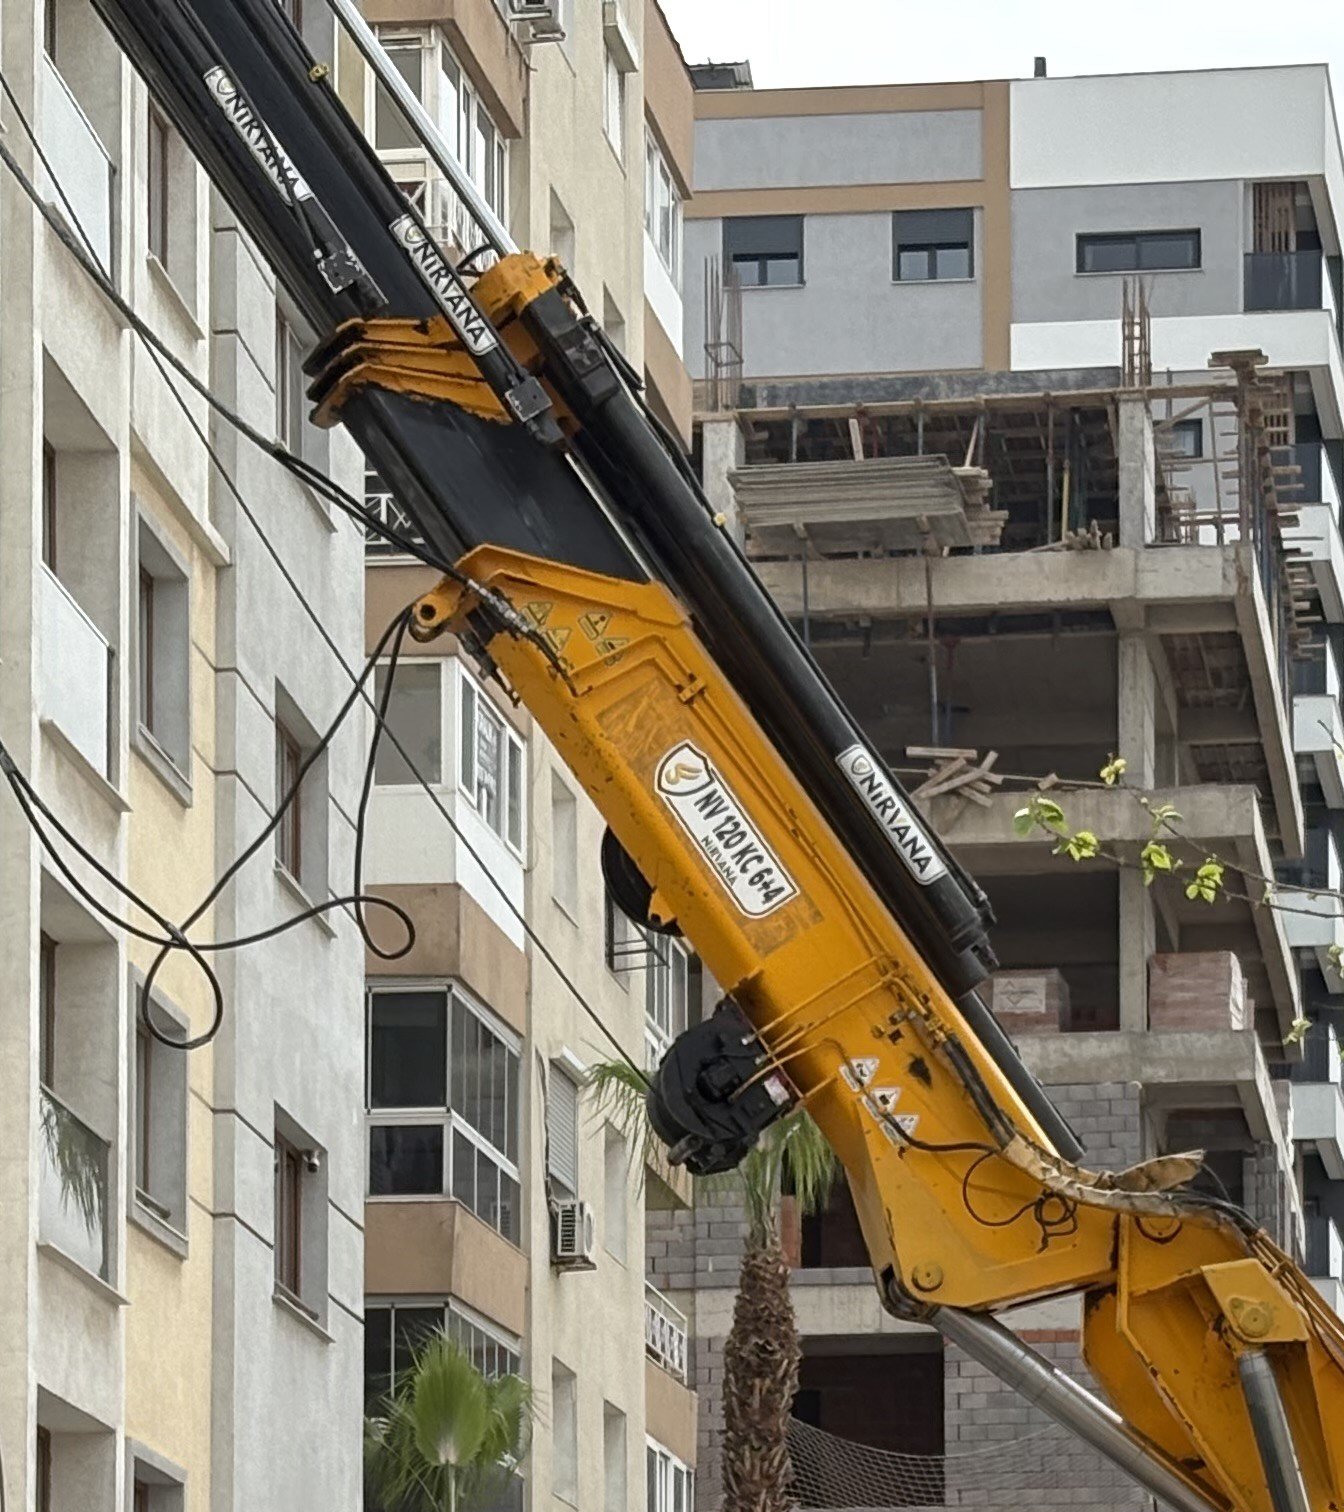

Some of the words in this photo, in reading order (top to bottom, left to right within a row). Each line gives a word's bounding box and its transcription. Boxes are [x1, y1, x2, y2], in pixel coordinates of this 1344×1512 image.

[693, 788, 731, 822] NV
[712, 813, 750, 851] 120
[730, 842, 766, 877] KC
[746, 865, 786, 906] 6+4
